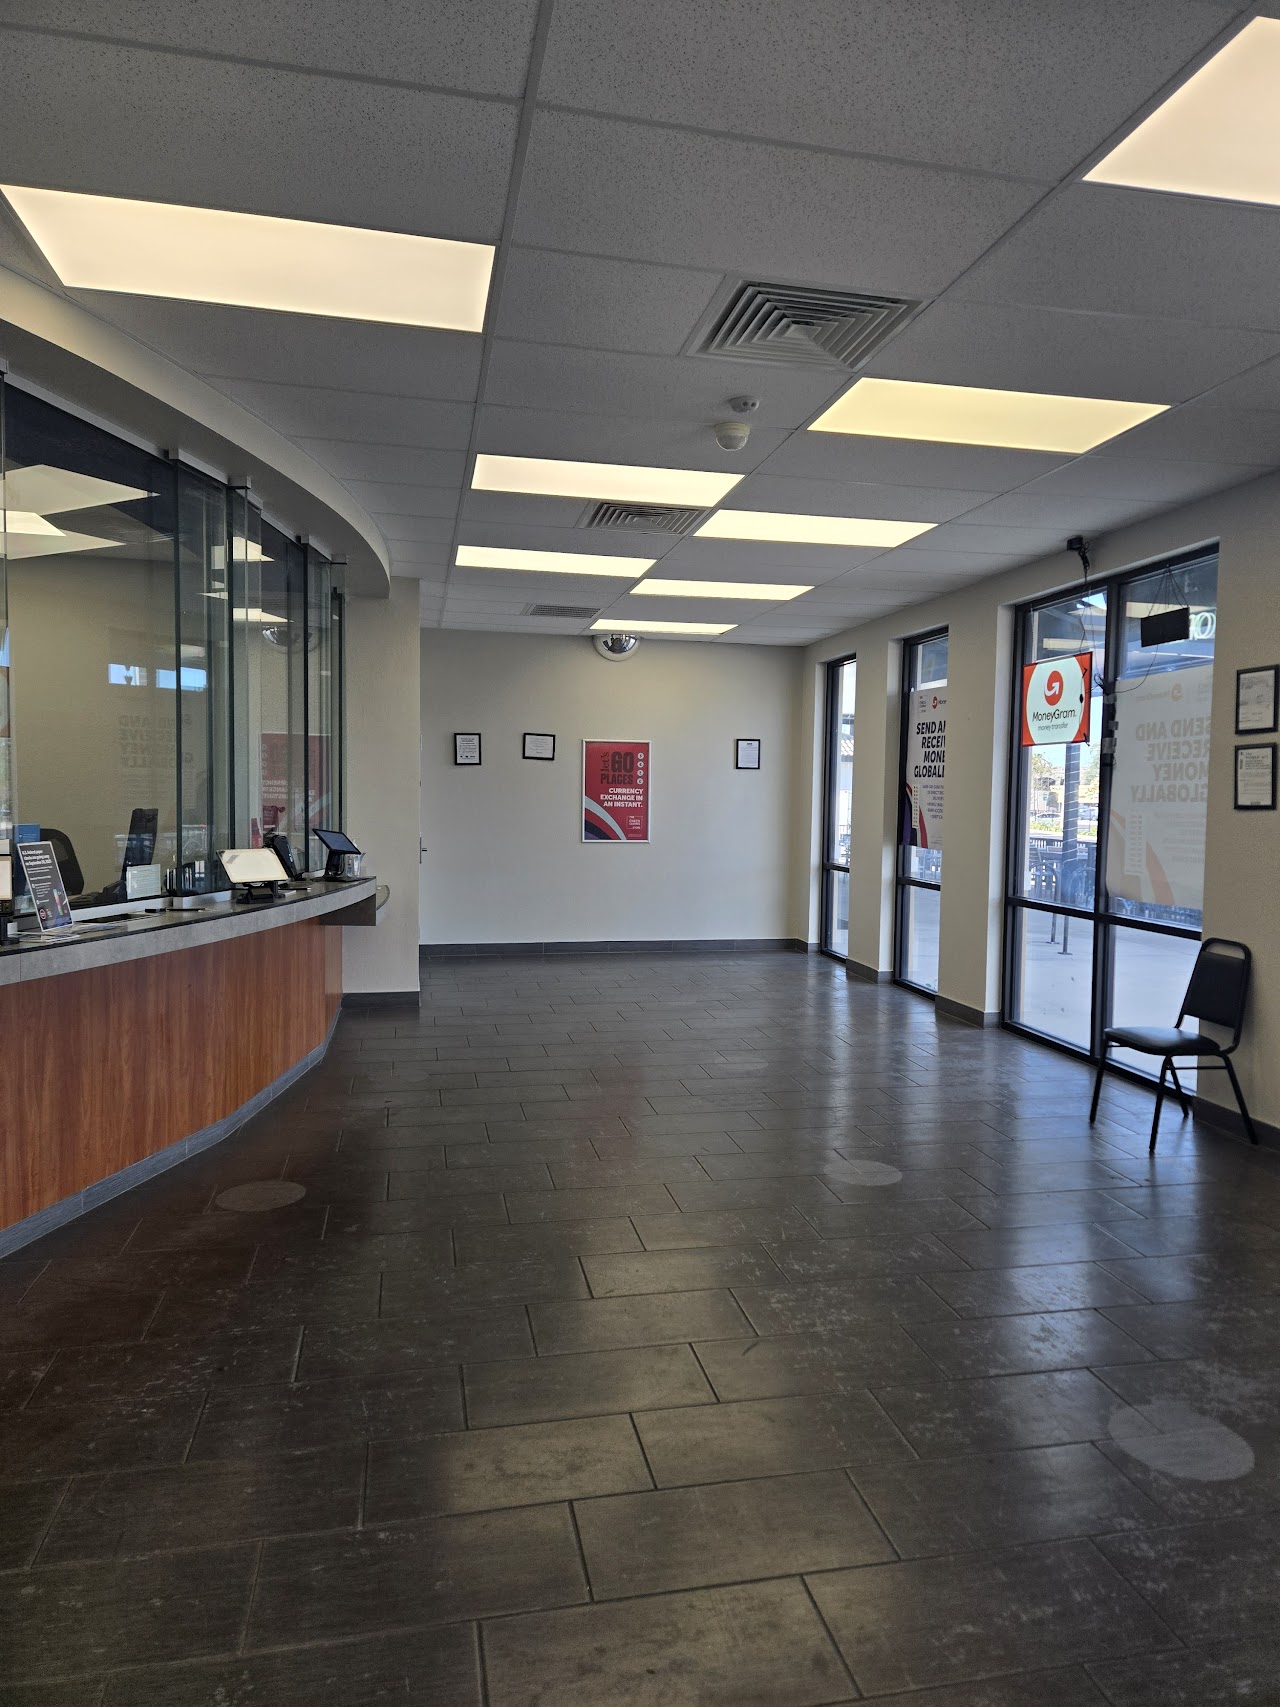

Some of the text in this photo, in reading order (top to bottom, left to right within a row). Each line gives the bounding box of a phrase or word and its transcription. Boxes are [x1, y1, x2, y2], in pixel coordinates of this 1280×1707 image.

[916, 721, 937, 735] SEND
[1051, 722, 1068, 730] transfer
[611, 751, 634, 773] GO
[600, 774, 634, 785] PLACES
